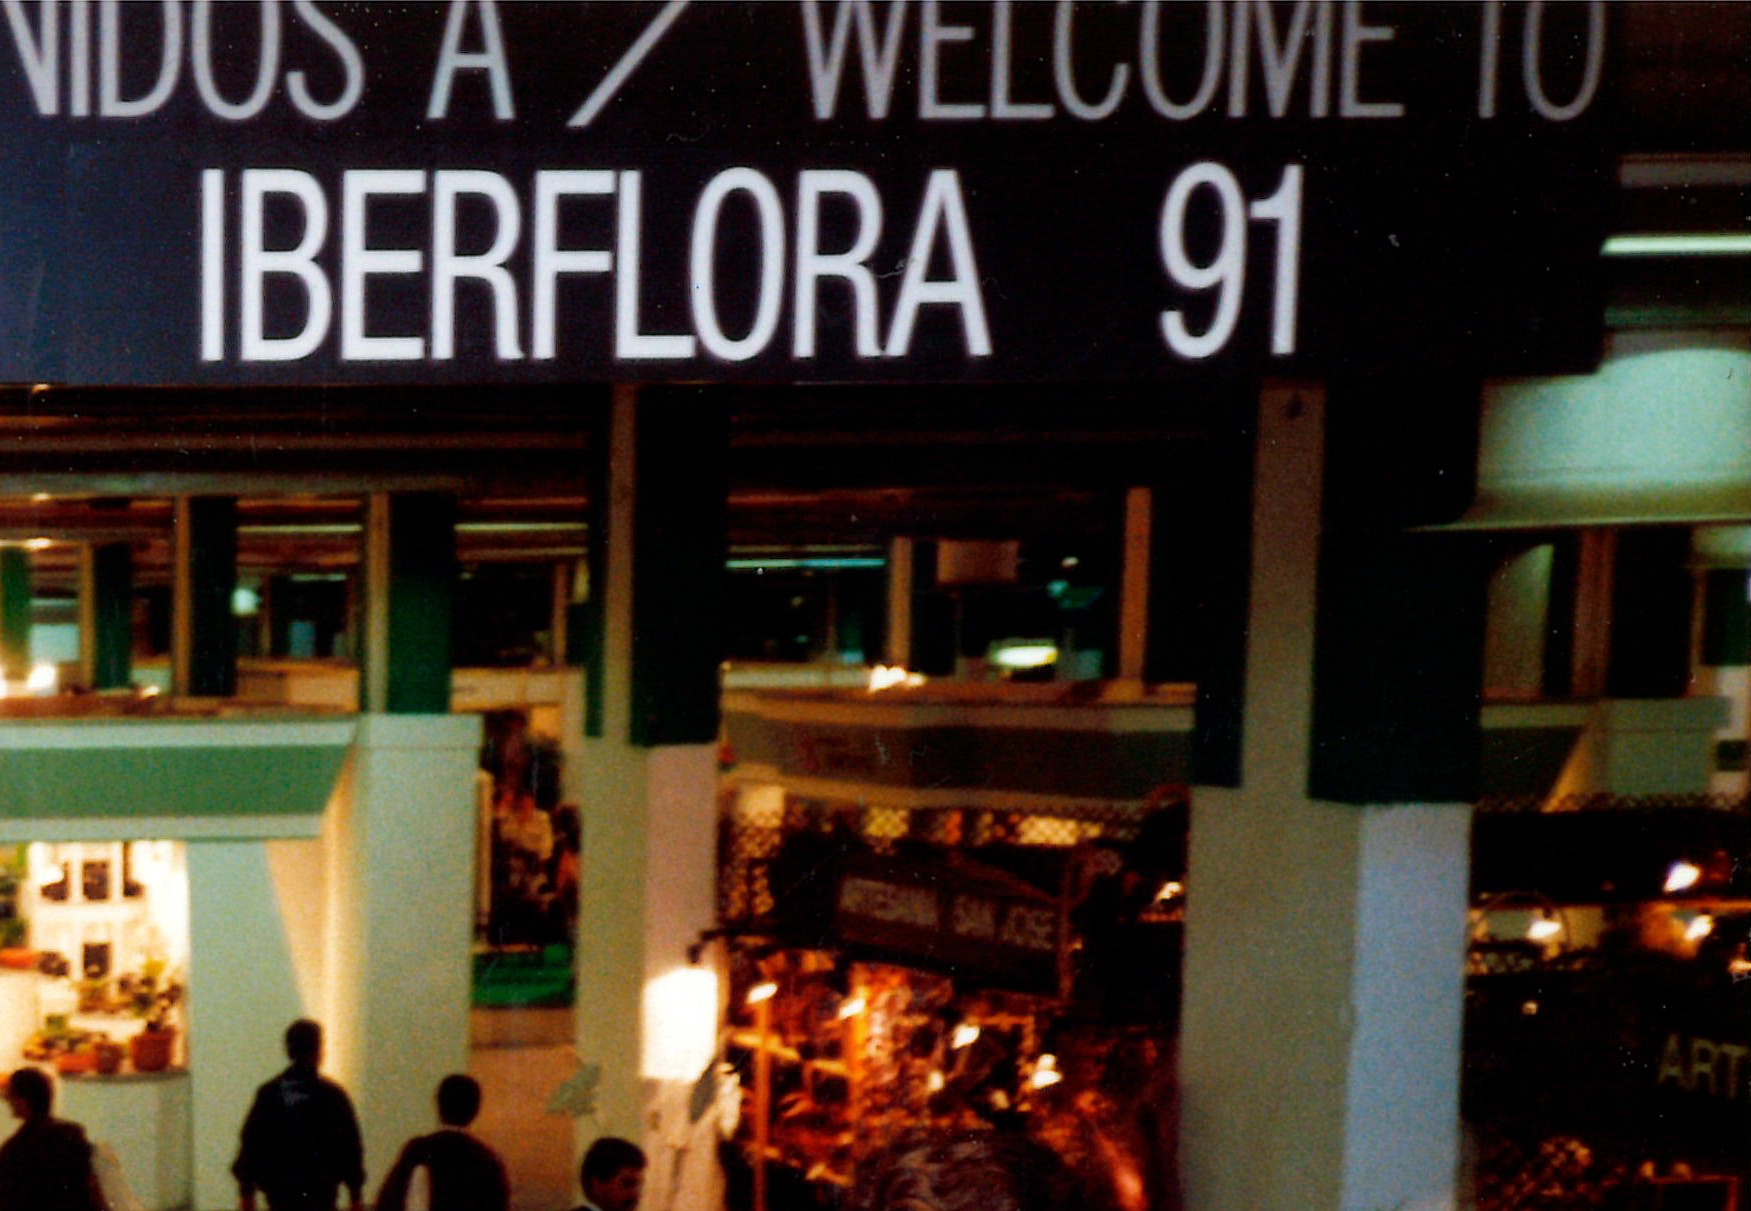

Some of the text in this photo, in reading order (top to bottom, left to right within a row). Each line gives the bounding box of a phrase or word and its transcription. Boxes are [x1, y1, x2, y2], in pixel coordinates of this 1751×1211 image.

[427, 0, 516, 121] A
[800, 0, 1404, 121] WELCOME
[1476, 0, 1606, 121] TO
[201, 162, 1302, 362] IBERFLORA 91
